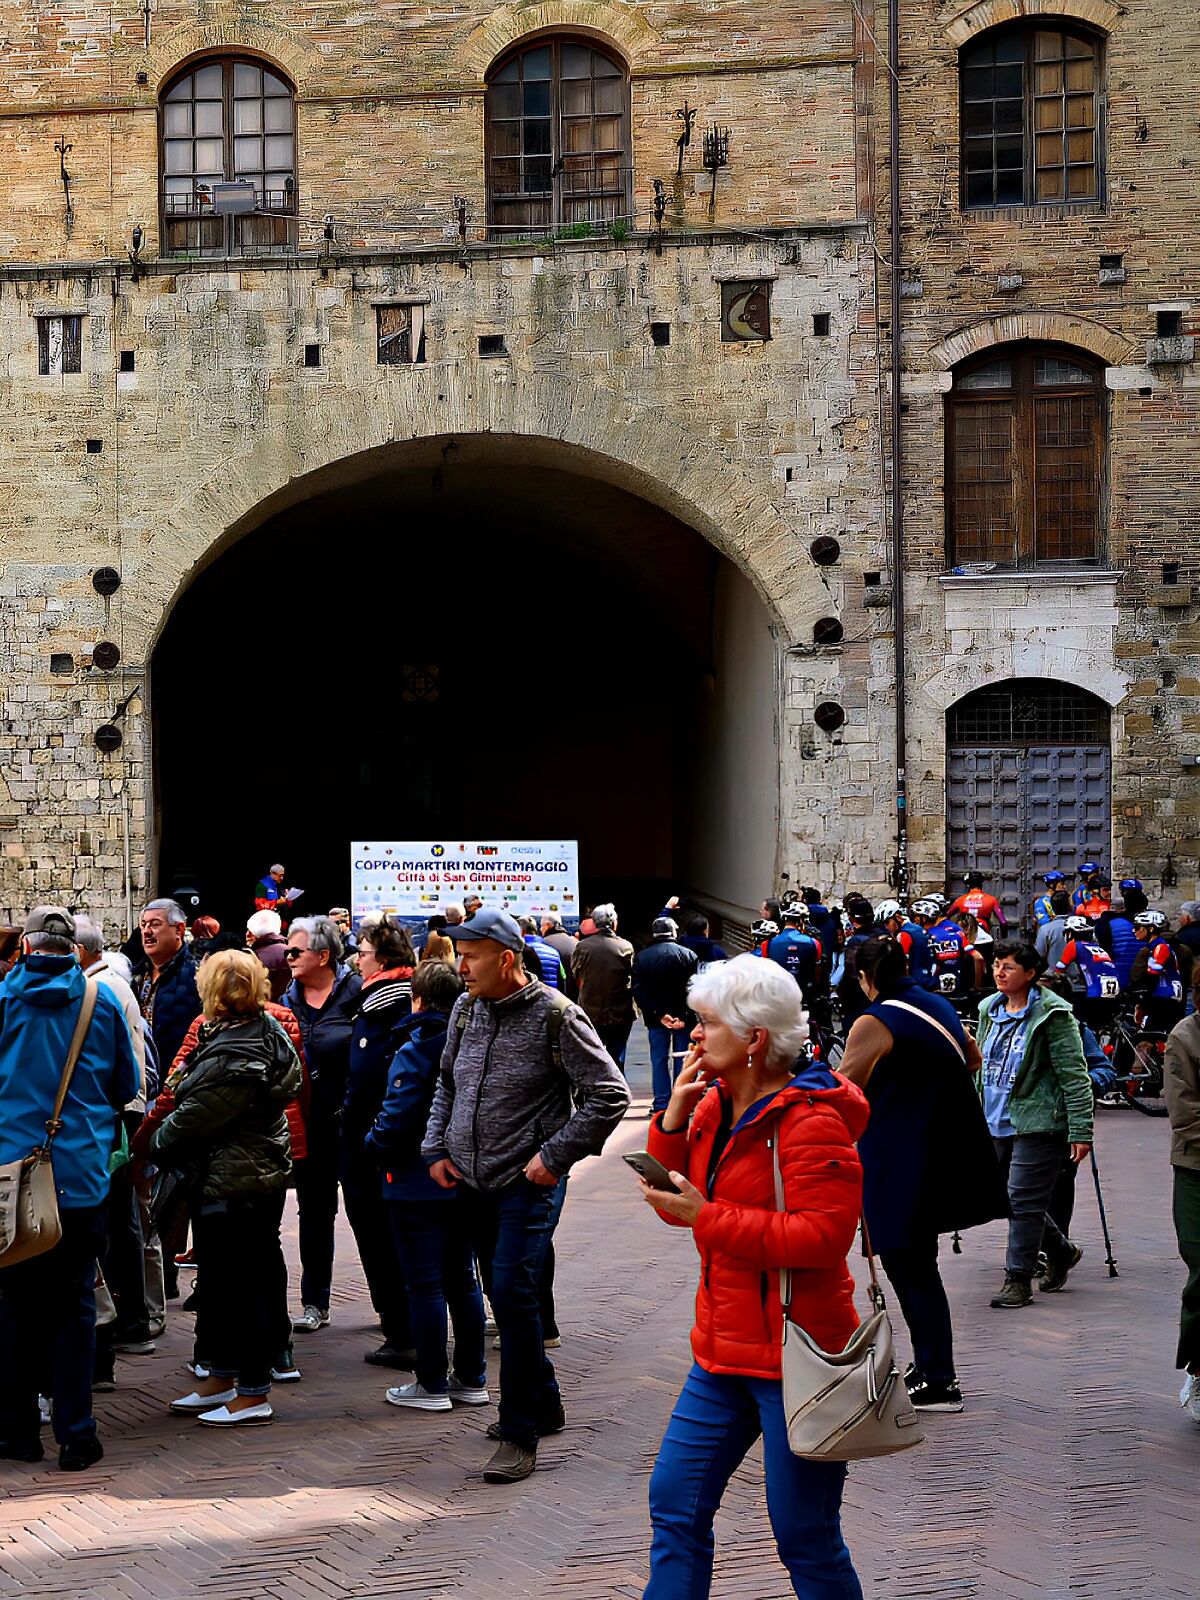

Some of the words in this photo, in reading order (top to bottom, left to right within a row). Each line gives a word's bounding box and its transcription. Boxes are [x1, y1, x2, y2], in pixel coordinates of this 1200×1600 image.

[354, 860, 401, 870] COPPA
[402, 861, 460, 871] MARTIRI
[463, 861, 568, 872] MONTEMAGGIO
[429, 872, 440, 882] di
[444, 873, 466, 882] San
[469, 872, 532, 882] Gimignano
